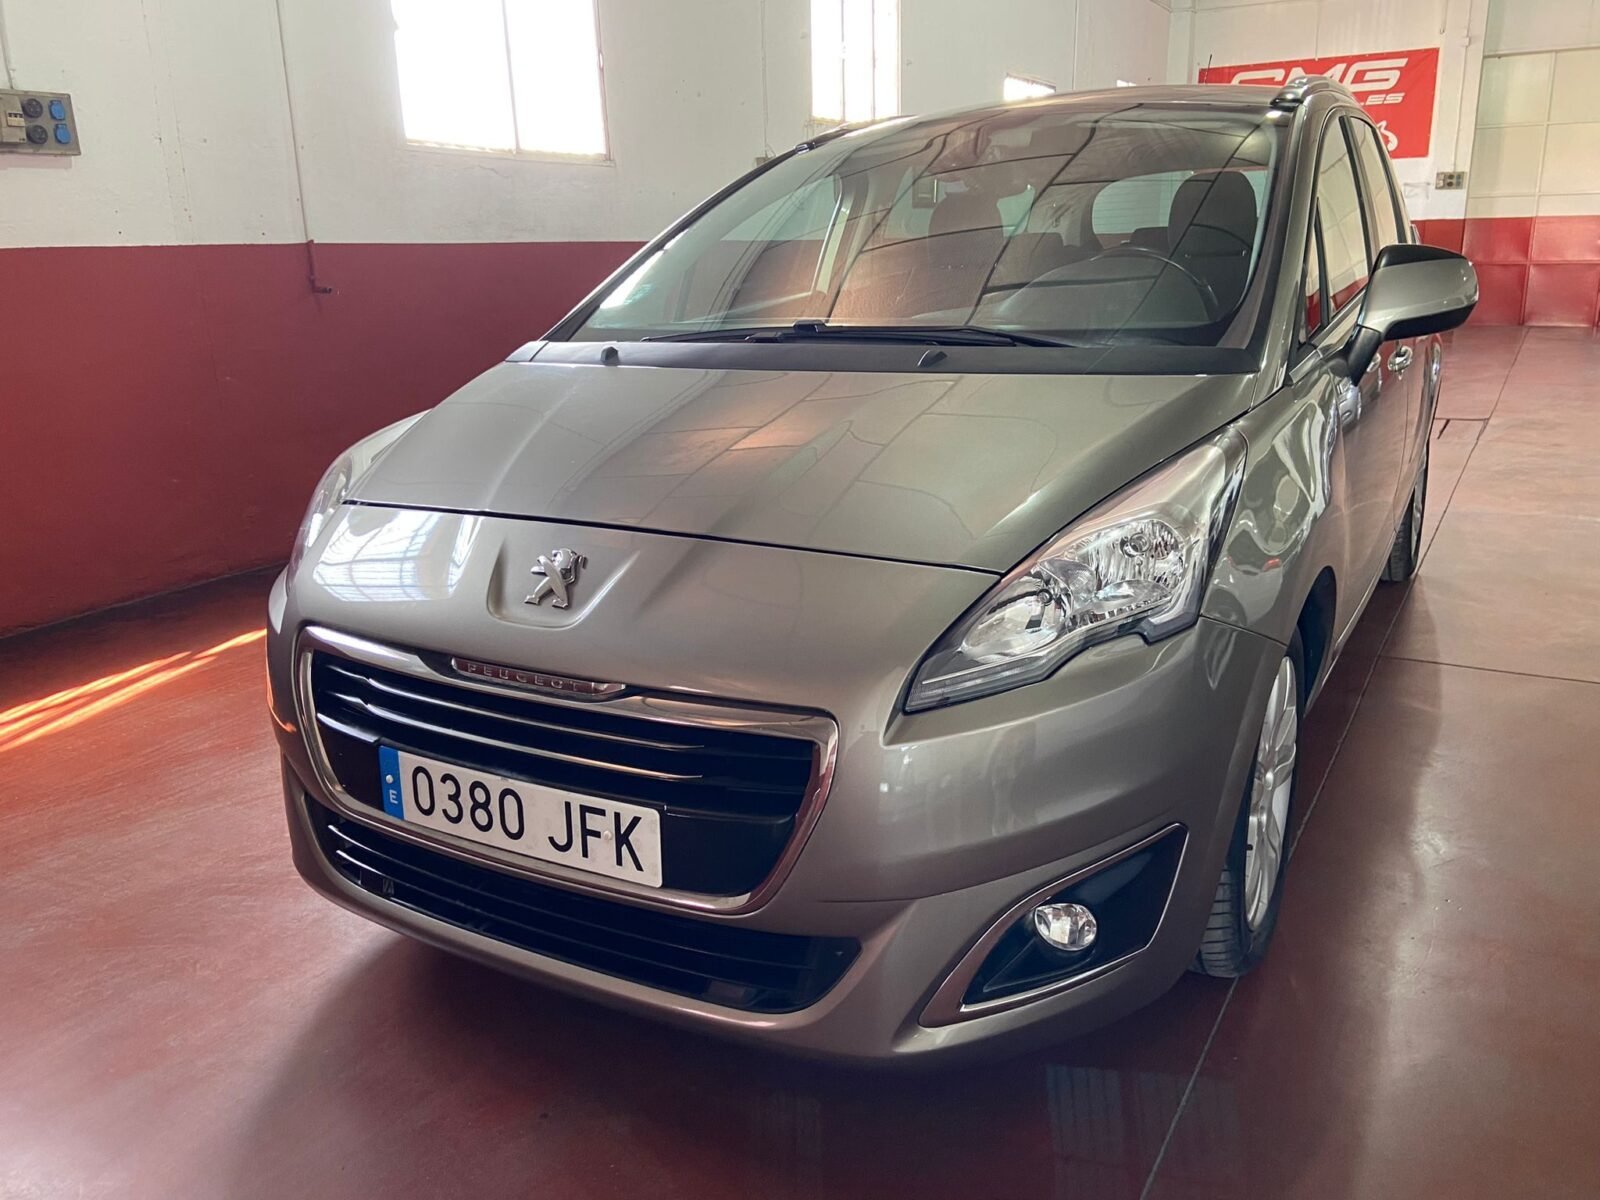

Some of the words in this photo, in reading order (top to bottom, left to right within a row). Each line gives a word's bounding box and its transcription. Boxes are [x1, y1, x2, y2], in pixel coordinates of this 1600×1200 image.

[466, 662, 582, 692] PEUGEOT
[388, 789, 399, 804] E
[411, 765, 525, 841] 0380
[547, 800, 645, 872] JFK
